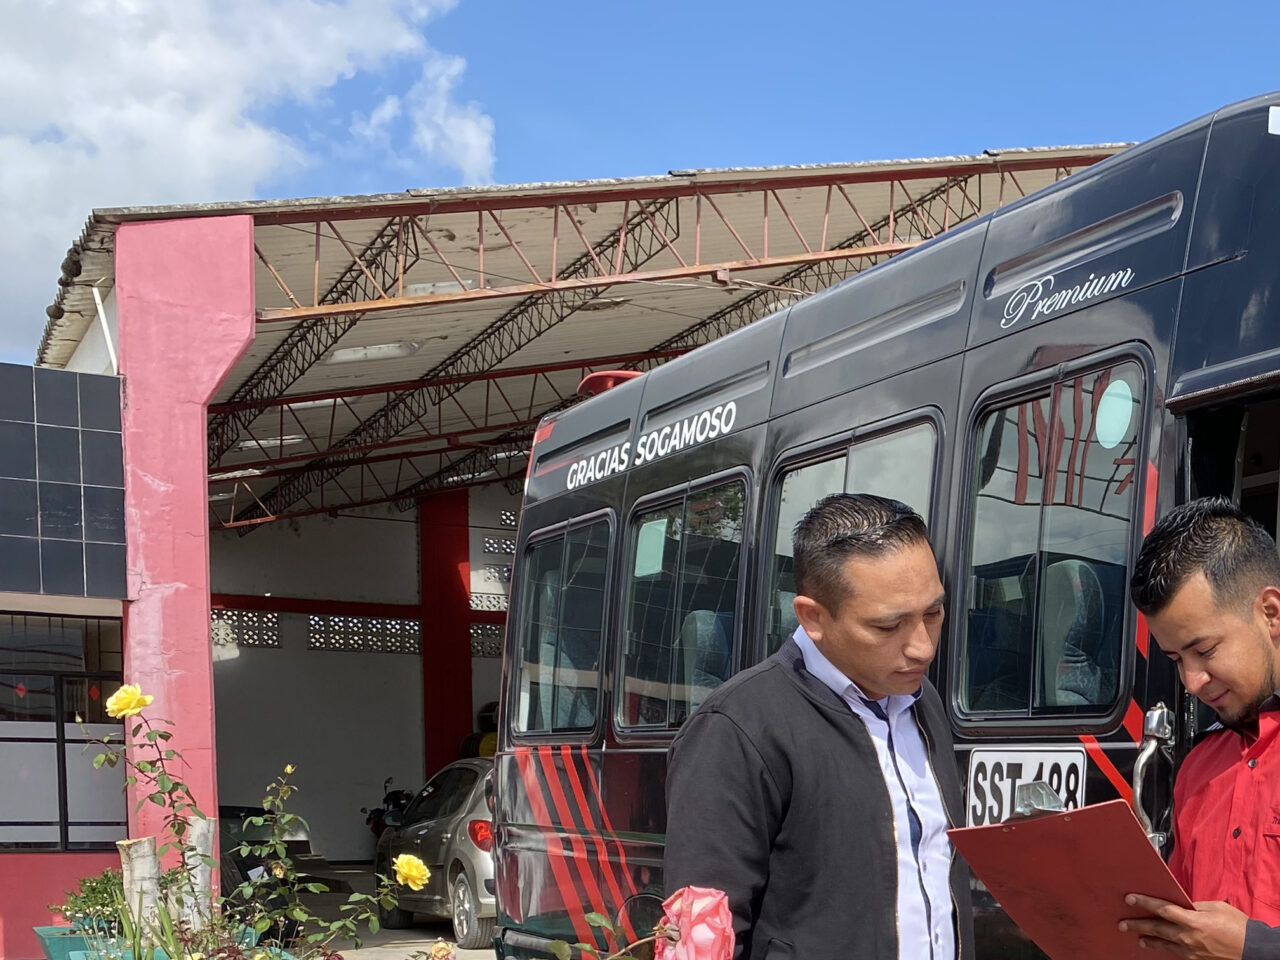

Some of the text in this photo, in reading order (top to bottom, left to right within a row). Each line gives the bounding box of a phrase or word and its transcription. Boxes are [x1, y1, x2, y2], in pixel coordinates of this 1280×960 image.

[999, 267, 1136, 329] Premium
[566, 401, 737, 490] GRACIAS SOGAMOSO
[971, 761, 1023, 827] SST
